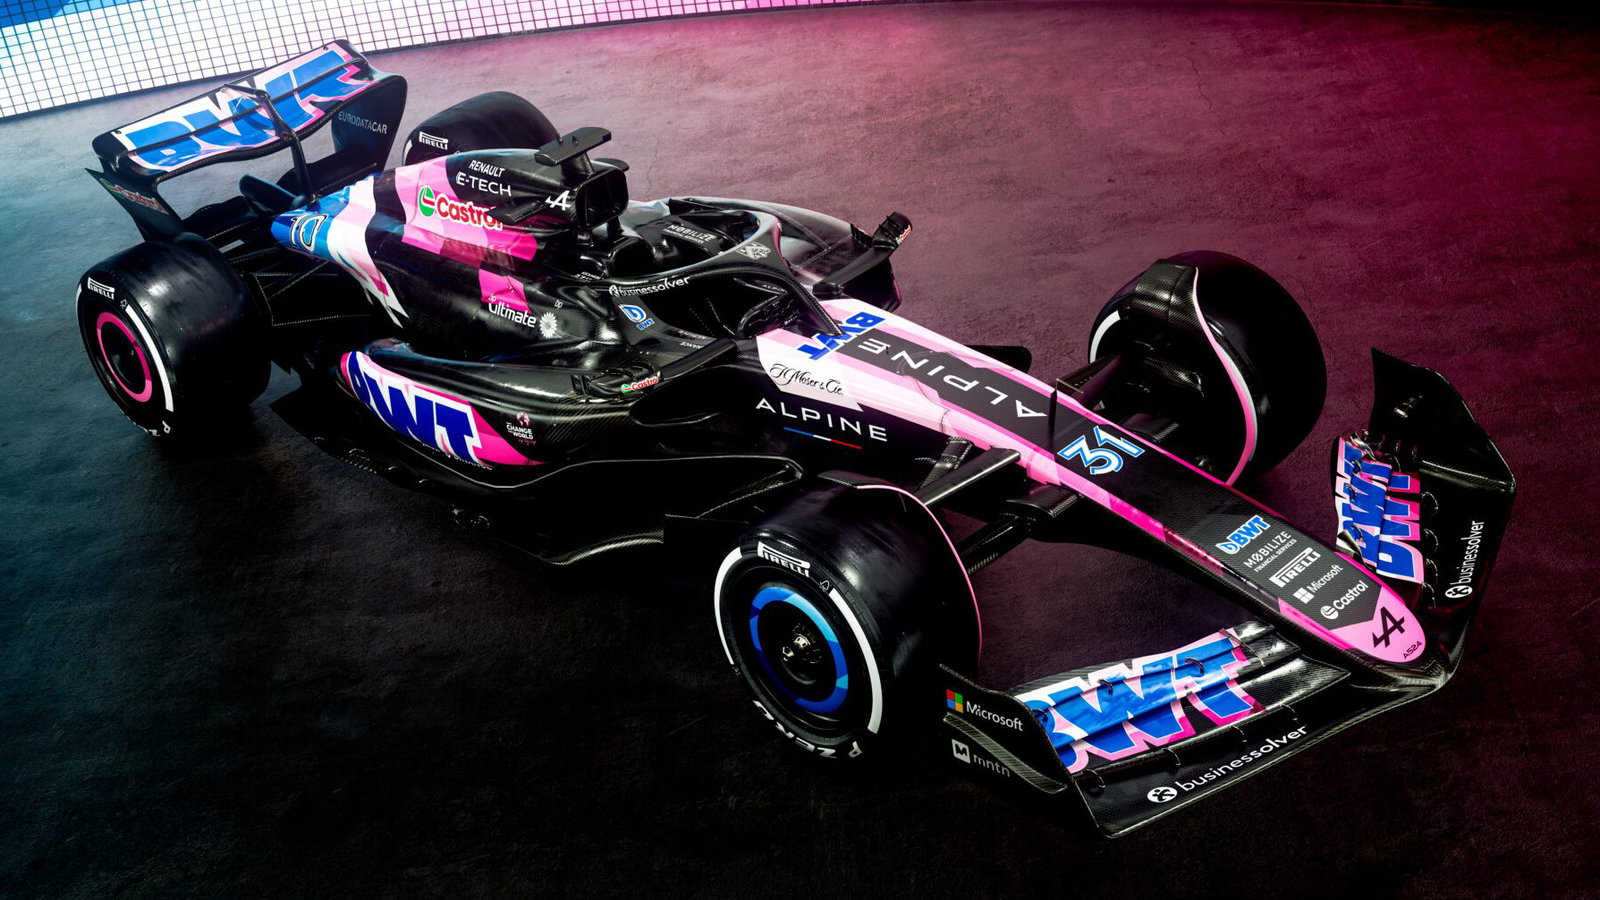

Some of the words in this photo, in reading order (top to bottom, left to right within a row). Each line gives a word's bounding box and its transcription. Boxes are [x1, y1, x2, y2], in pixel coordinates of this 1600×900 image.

[116, 46, 375, 170] BWT
[338, 110, 388, 135] EURODATACAR
[418, 130, 449, 150] PIRELLI
[456, 171, 512, 197] E-TECH
[469, 160, 505, 178] RENAULT
[87, 277, 116, 300] PIRELLI
[617, 276, 691, 298] businessolver
[488, 301, 537, 329] ultimate
[554, 298, 564, 309] bp
[636, 317, 655, 331] BWT
[797, 311, 886, 361] BWT
[631, 375, 660, 392] Castrol
[857, 338, 1048, 418] ALPINE
[347, 351, 479, 464] BWT
[755, 397, 888, 442] ALPINE
[505, 423, 533, 435] CHANGE
[512, 431, 534, 440] WORLD
[1056, 424, 1146, 476] 31
[1338, 438, 1421, 581] BWT
[1233, 514, 1272, 548] BWT
[757, 541, 811, 578] PIRELLI
[1253, 552, 1279, 573] FINANCIAL
[1276, 538, 1298, 557] SERVICES
[1269, 547, 1322, 588] PIRELLI
[1449, 519, 1485, 585] businessolver
[1307, 563, 1344, 594] Microsoft
[1332, 579, 1369, 611] Castrol
[1403, 640, 1423, 660] A524
[966, 699, 1025, 732] Microsoft
[972, 753, 1012, 777] mntn
[1178, 724, 1309, 794] businessolver
